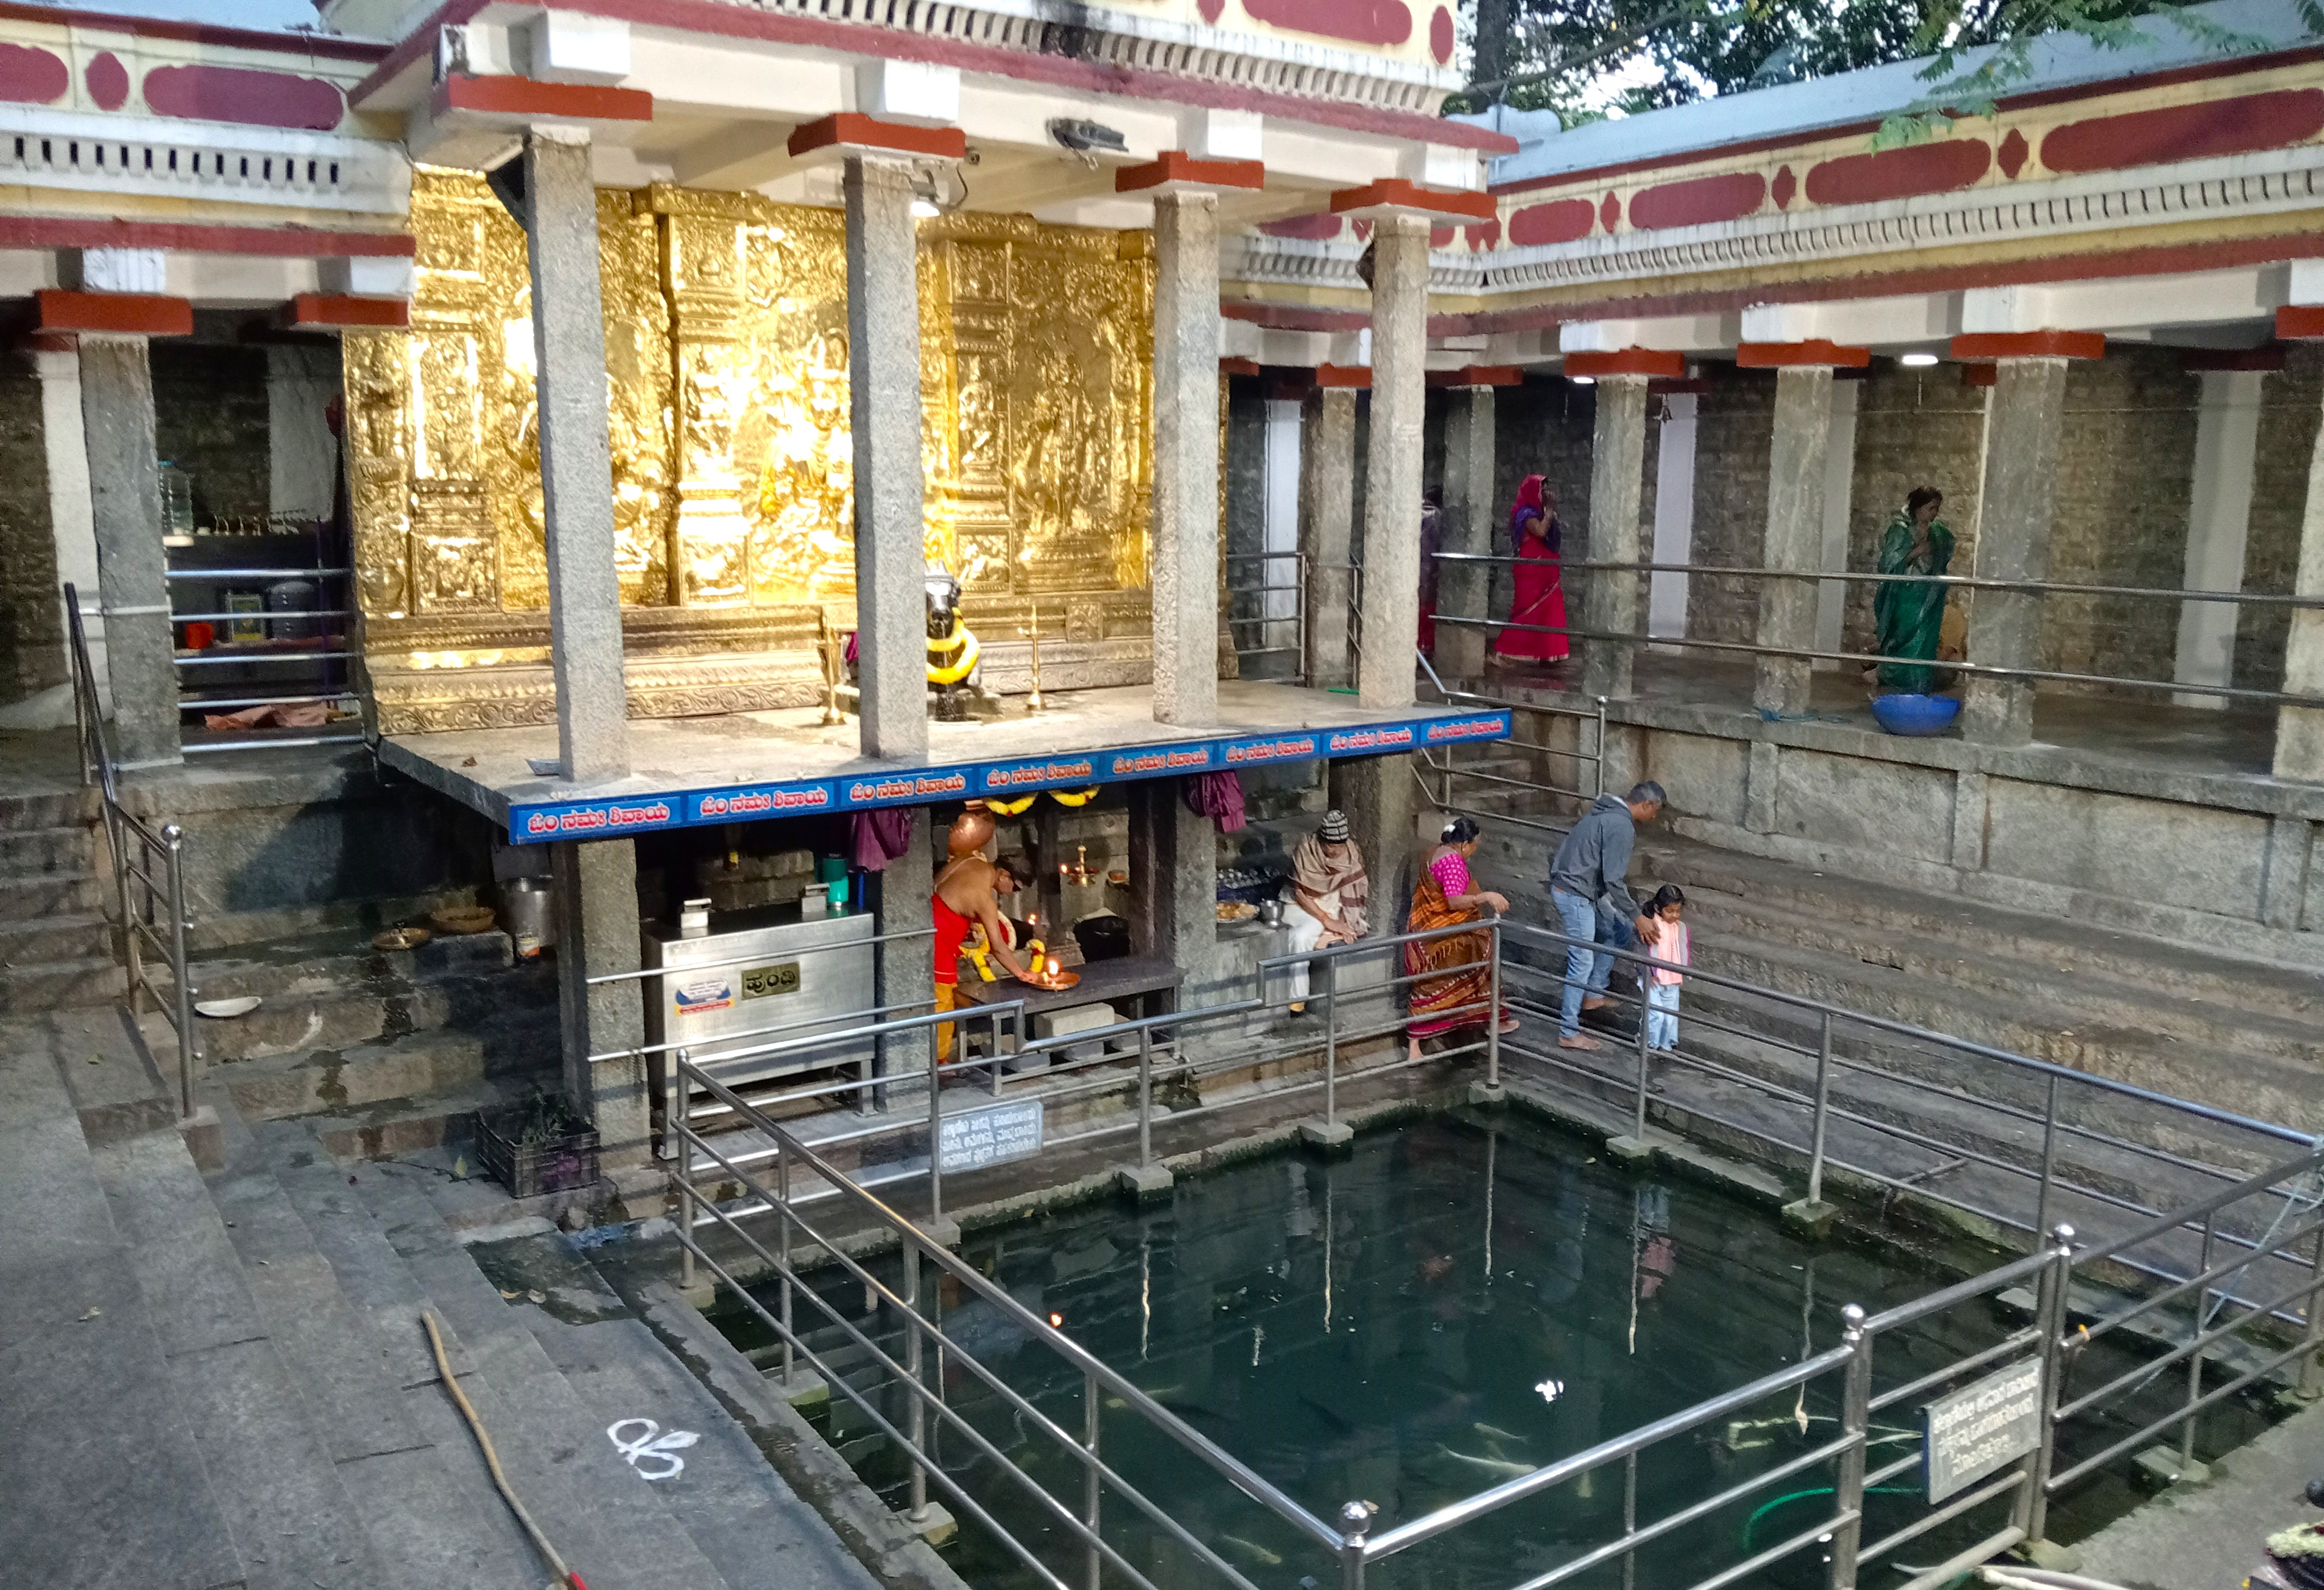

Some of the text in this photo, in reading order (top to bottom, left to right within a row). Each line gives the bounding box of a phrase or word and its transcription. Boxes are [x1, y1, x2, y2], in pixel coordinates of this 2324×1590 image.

[1167, 747, 1208, 767] ಶಿವಾಯ
[1276, 738, 1314, 757] ಶಿವಾಯ
[987, 760, 1091, 786] ಓಂ ನಮಃ ಶಿವಾಯ
[850, 772, 965, 801] ಓಂ ನಮಃ ಶಿವಾಯ
[701, 786, 828, 815] ಓಂ ನಮಃ ಶಿವಾಯ
[528, 802, 670, 833] ಓಂ ನಮಃ ಶಿವಾಯ
[746, 970, 796, 994] ಹುಂಡಿ
